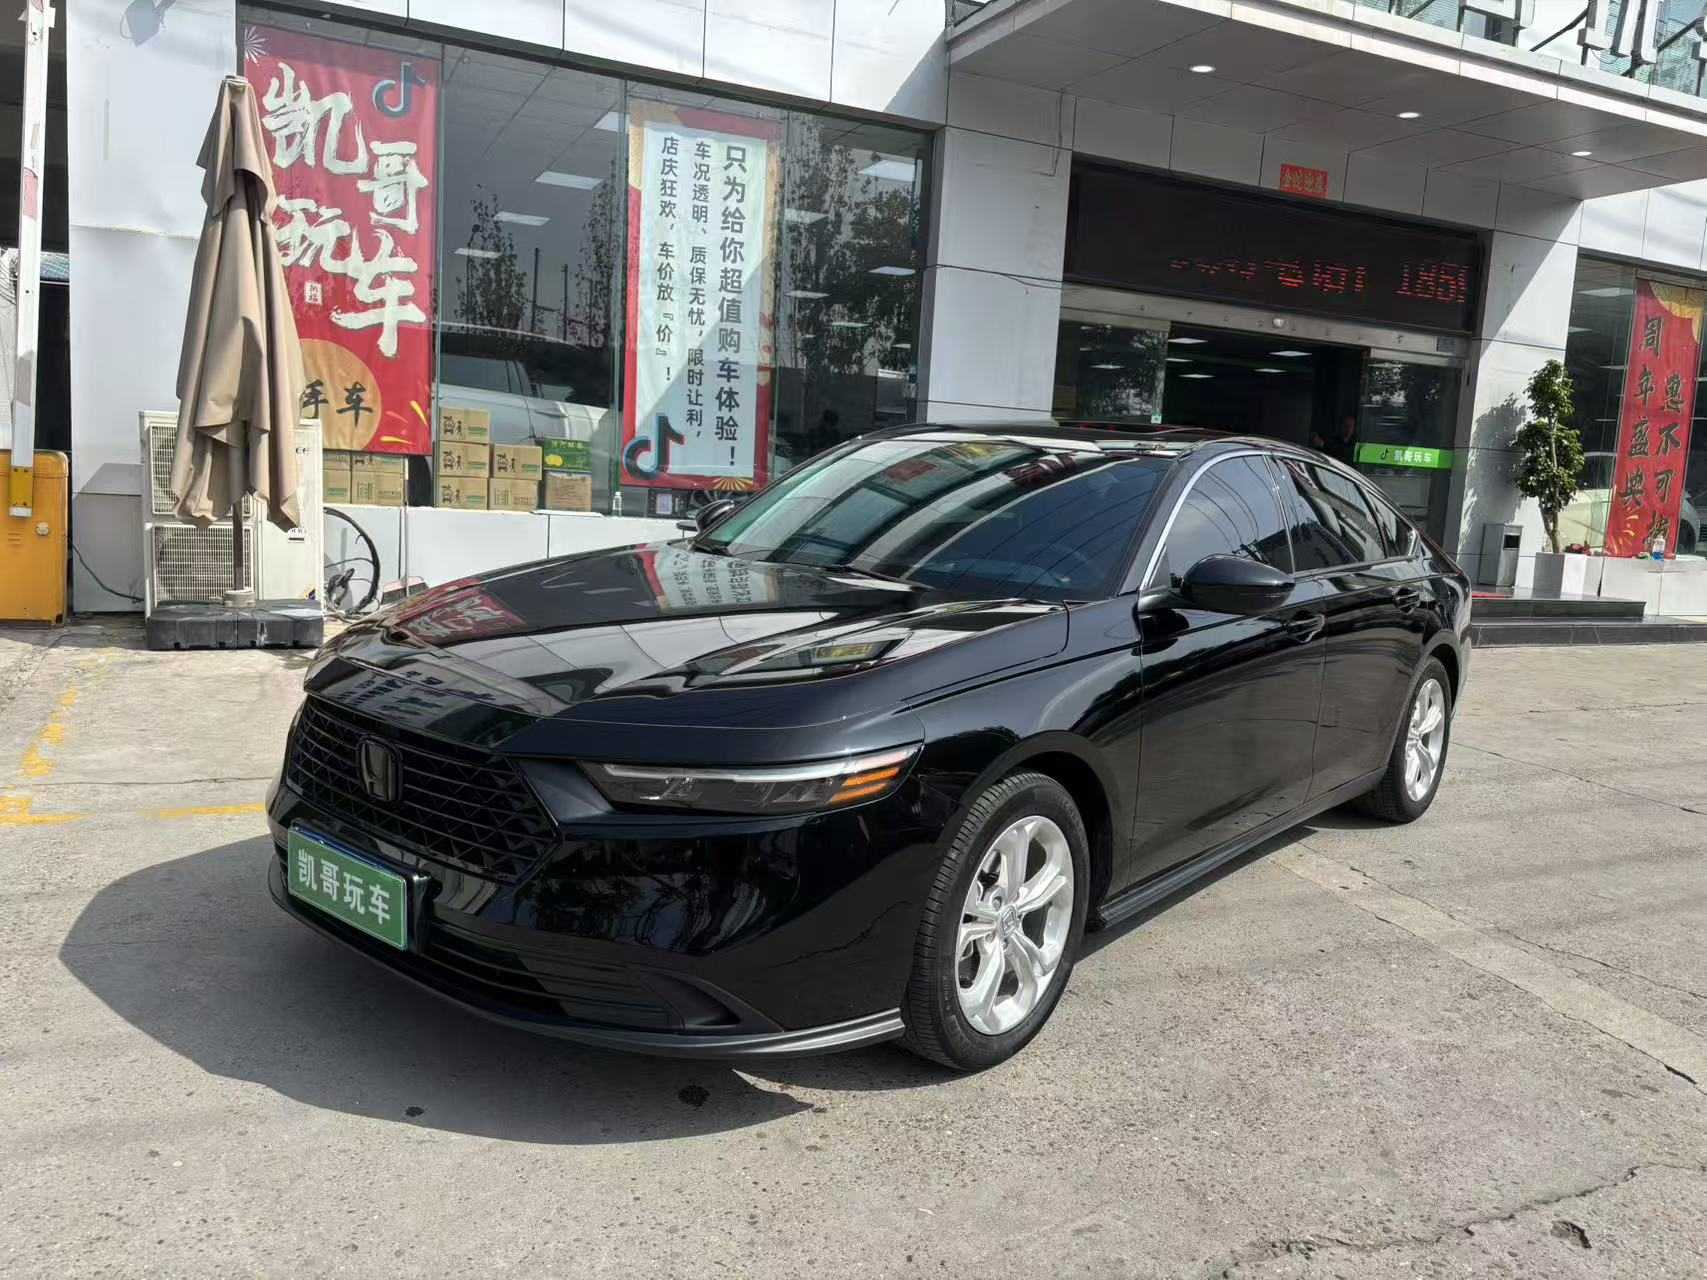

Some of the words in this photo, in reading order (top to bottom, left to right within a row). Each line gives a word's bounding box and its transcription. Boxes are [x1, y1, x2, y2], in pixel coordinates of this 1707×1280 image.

[714, 145, 748, 466] 只为给你超值购车体验！
[1617, 315, 1665, 508] 周年盛典
[297, 848, 391, 925] 凯哥玩车
